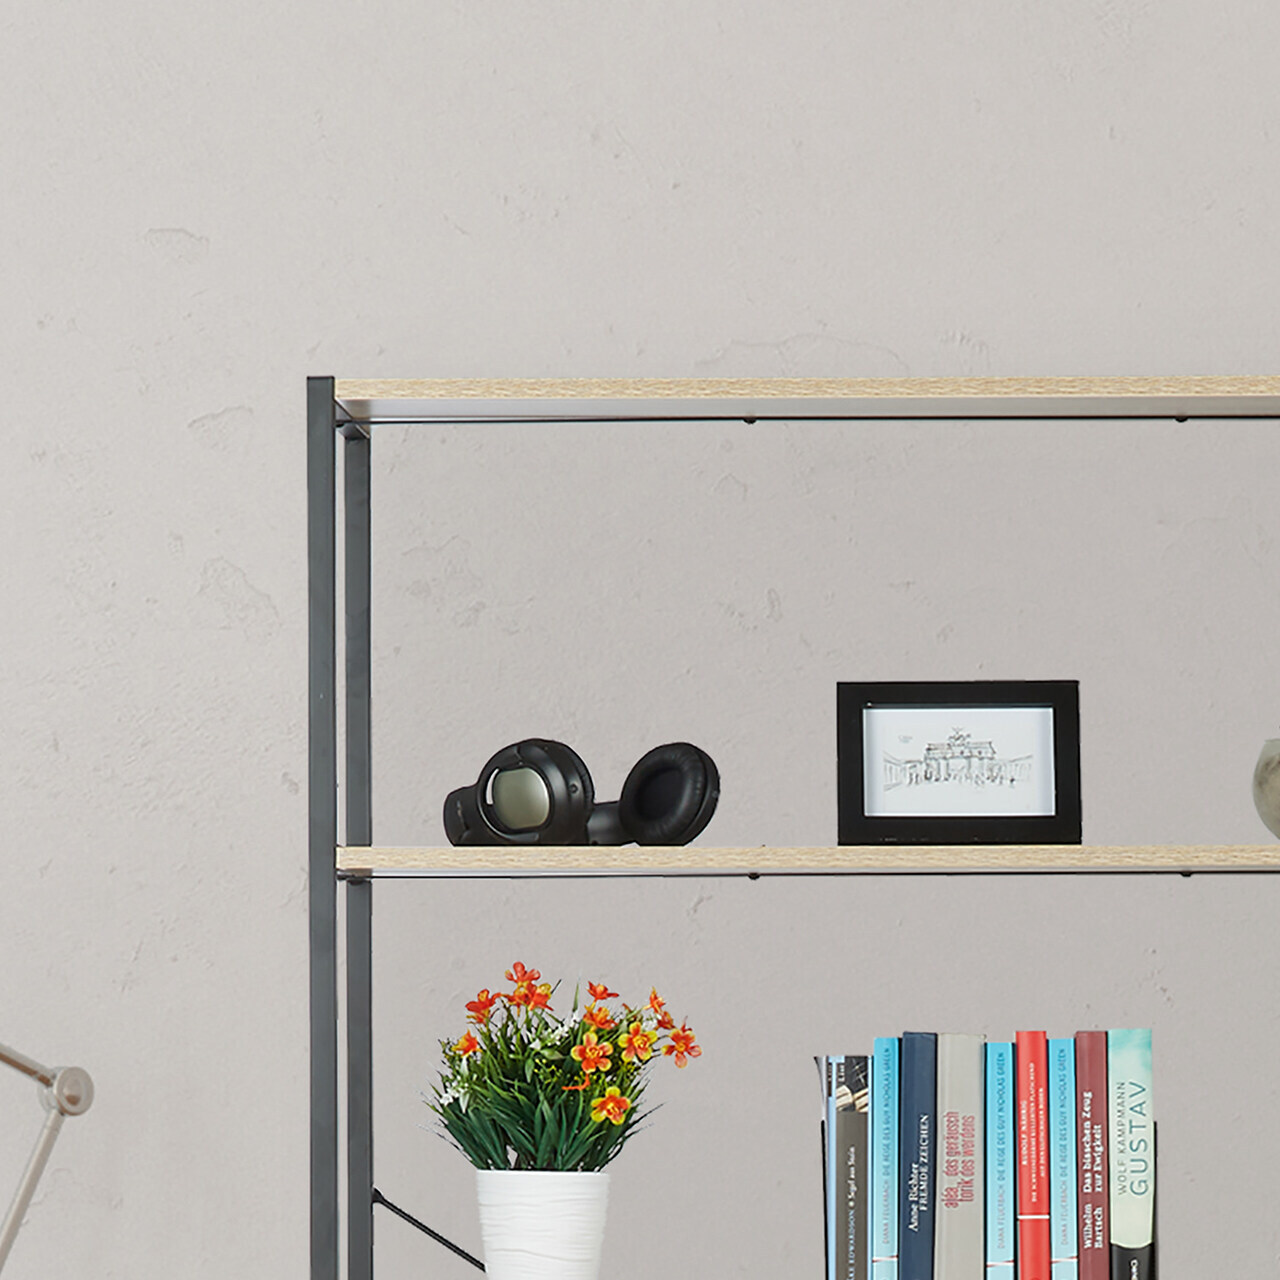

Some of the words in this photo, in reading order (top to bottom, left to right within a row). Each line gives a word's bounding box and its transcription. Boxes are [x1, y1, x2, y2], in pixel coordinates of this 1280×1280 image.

[997, 1053, 1005, 1075] GREEN
[1058, 1049, 1066, 1071] GREEN
[882, 1073, 890, 1108] NICHOLAS
[997, 1078, 1005, 1112] NICHOLAS
[1058, 1074, 1067, 1109] NICHOLAS
[1059, 1110, 1067, 1125] GUY
[1082, 1092, 1093, 1118] Zeug
[1116, 1082, 1126, 1154] KAMPMANN
[942, 1112, 960, 1156] geräusch
[997, 1114, 1005, 1129] GUY
[1059, 1127, 1067, 1141] DES
[918, 1115, 929, 1163] ZEICHEN
[960, 1115, 974, 1157] werdens
[997, 1132, 1005, 1145] DES
[1082, 1121, 1092, 1170] bisschen
[1092, 1124, 1104, 1171] Ewigkeit
[1129, 1081, 1148, 1196] GUSTAV
[882, 1165, 890, 1176] DIE
[942, 1159, 958, 1176] das
[960, 1160, 974, 1176] des
[997, 1148, 1005, 1168] REISE
[1059, 1166, 1067, 1177] DIE
[909, 1162, 919, 1200] Richter
[918, 1165, 929, 1211] FREMDE
[997, 1169, 1005, 1181] DIE
[1082, 1172, 1092, 1193] Das
[1094, 1175, 1102, 1192] zur
[1117, 1160, 1127, 1195] WOLF
[909, 1204, 919, 1232] Anne
[1083, 1204, 1092, 1248] Wilhelm
[1094, 1207, 1103, 1248] Bartsch
